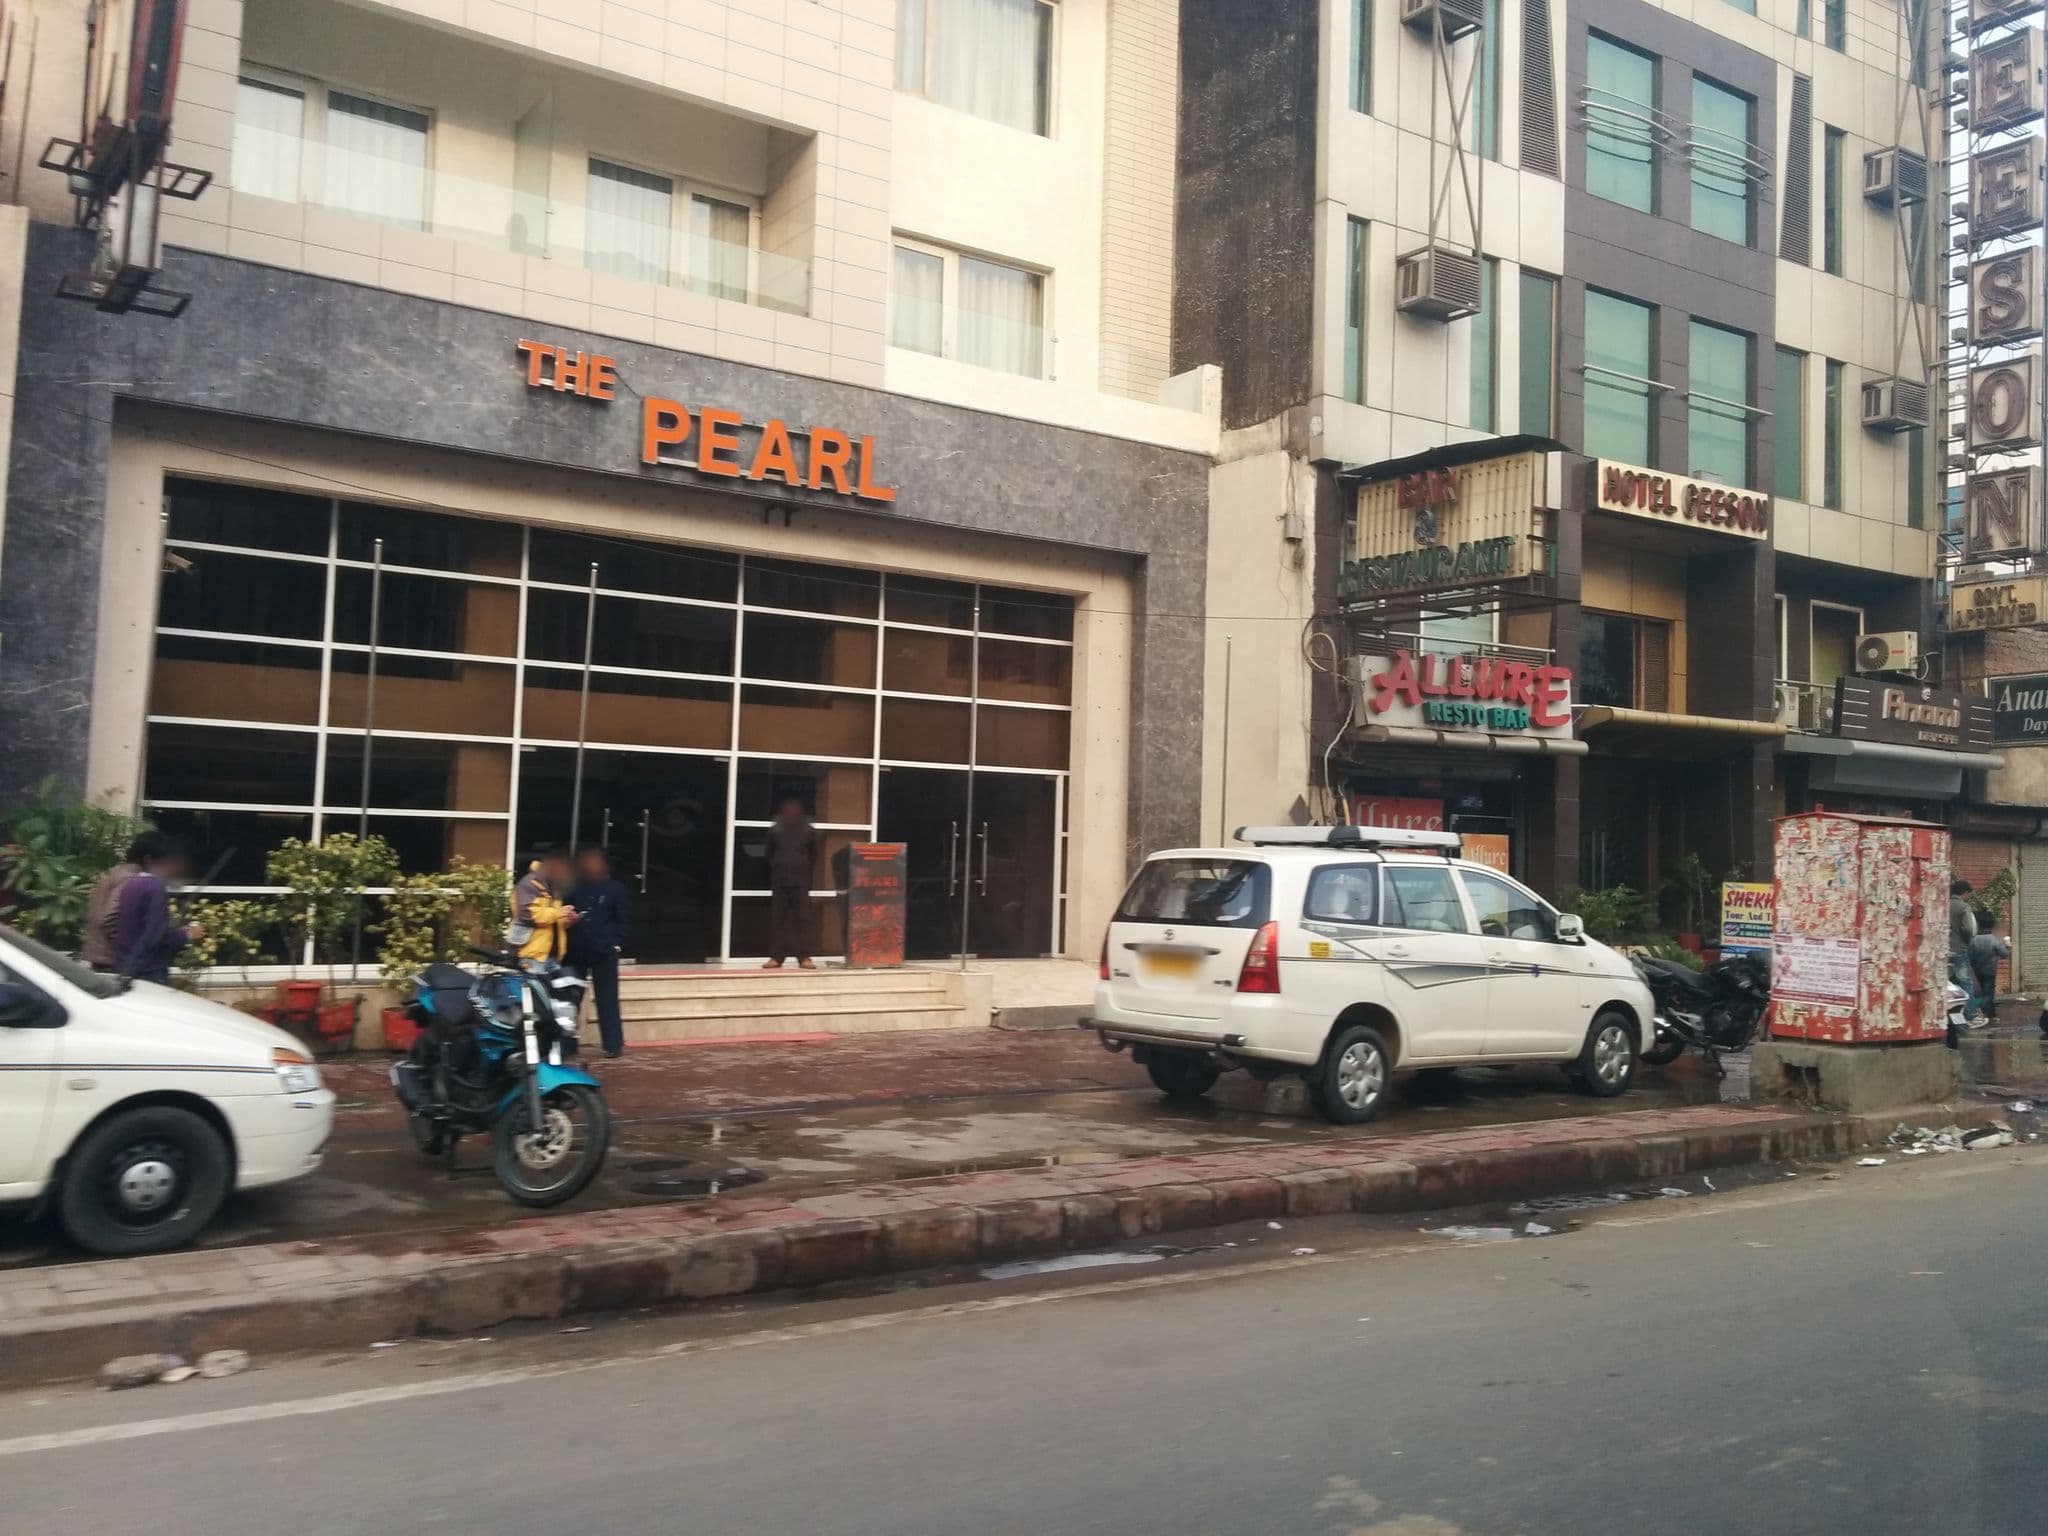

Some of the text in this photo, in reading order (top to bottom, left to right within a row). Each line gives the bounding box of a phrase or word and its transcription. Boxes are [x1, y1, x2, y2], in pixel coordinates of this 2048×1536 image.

[1972, 0, 2029, 550] EESON
[518, 338, 617, 401] THE
[641, 396, 896, 502] PEARL
[1397, 467, 1457, 509] BAR
[1603, 466, 1768, 533] HOTEL GEESON
[1337, 536, 1516, 594] RESTAURANT
[1369, 650, 1572, 728] ALLURE
[1424, 701, 1530, 730] RESTO BAR
